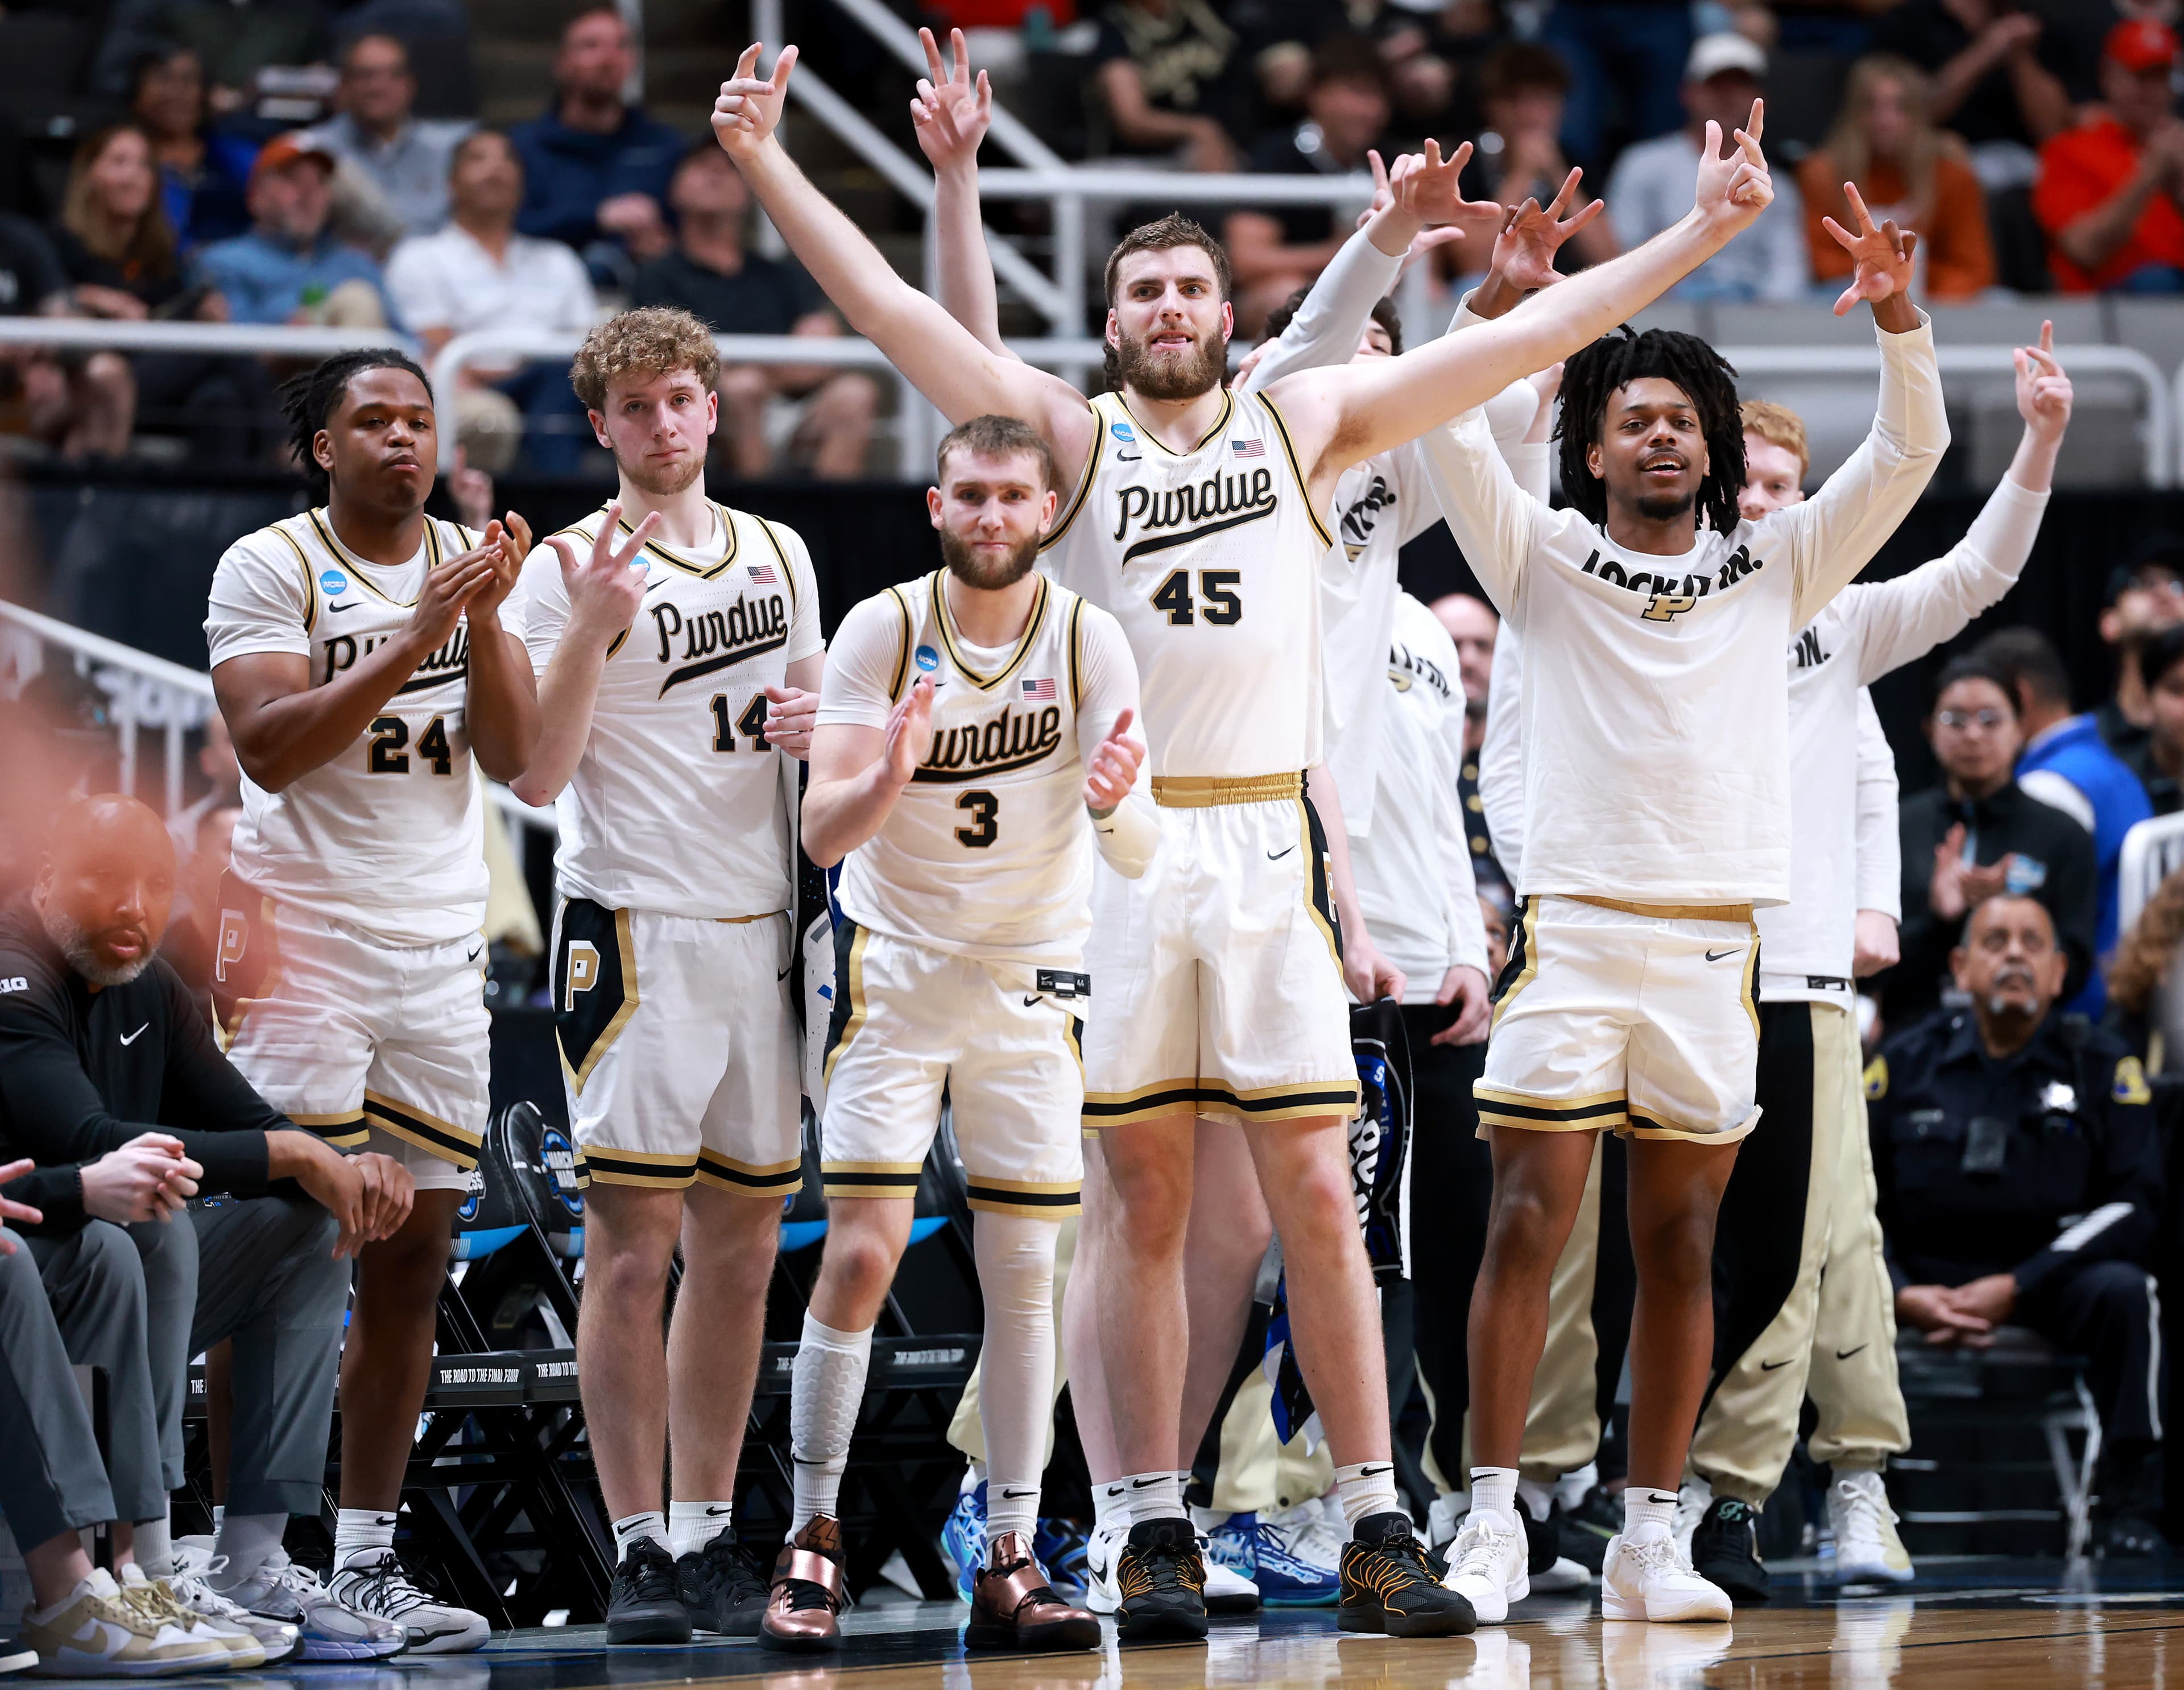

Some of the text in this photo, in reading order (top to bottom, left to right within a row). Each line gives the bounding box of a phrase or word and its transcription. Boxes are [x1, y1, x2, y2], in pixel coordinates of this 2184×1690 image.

[1113, 465, 1274, 542] Purdue
[647, 590, 788, 664] Purdue
[1149, 569, 1243, 627] 45
[1640, 594, 1697, 622] P
[366, 715, 452, 776] 24
[709, 693, 772, 753] 14
[920, 702, 1062, 769] urdue
[954, 789, 999, 848] 3
[565, 940, 601, 1012] P
[191, 1379, 204, 1394] THE
[440, 1368, 520, 1384] THE ROAD TO THE FINAL FOUR
[536, 1364, 548, 1378] THE
[548, 1362, 562, 1377] ROAD
[561, 1362, 569, 1376] TO
